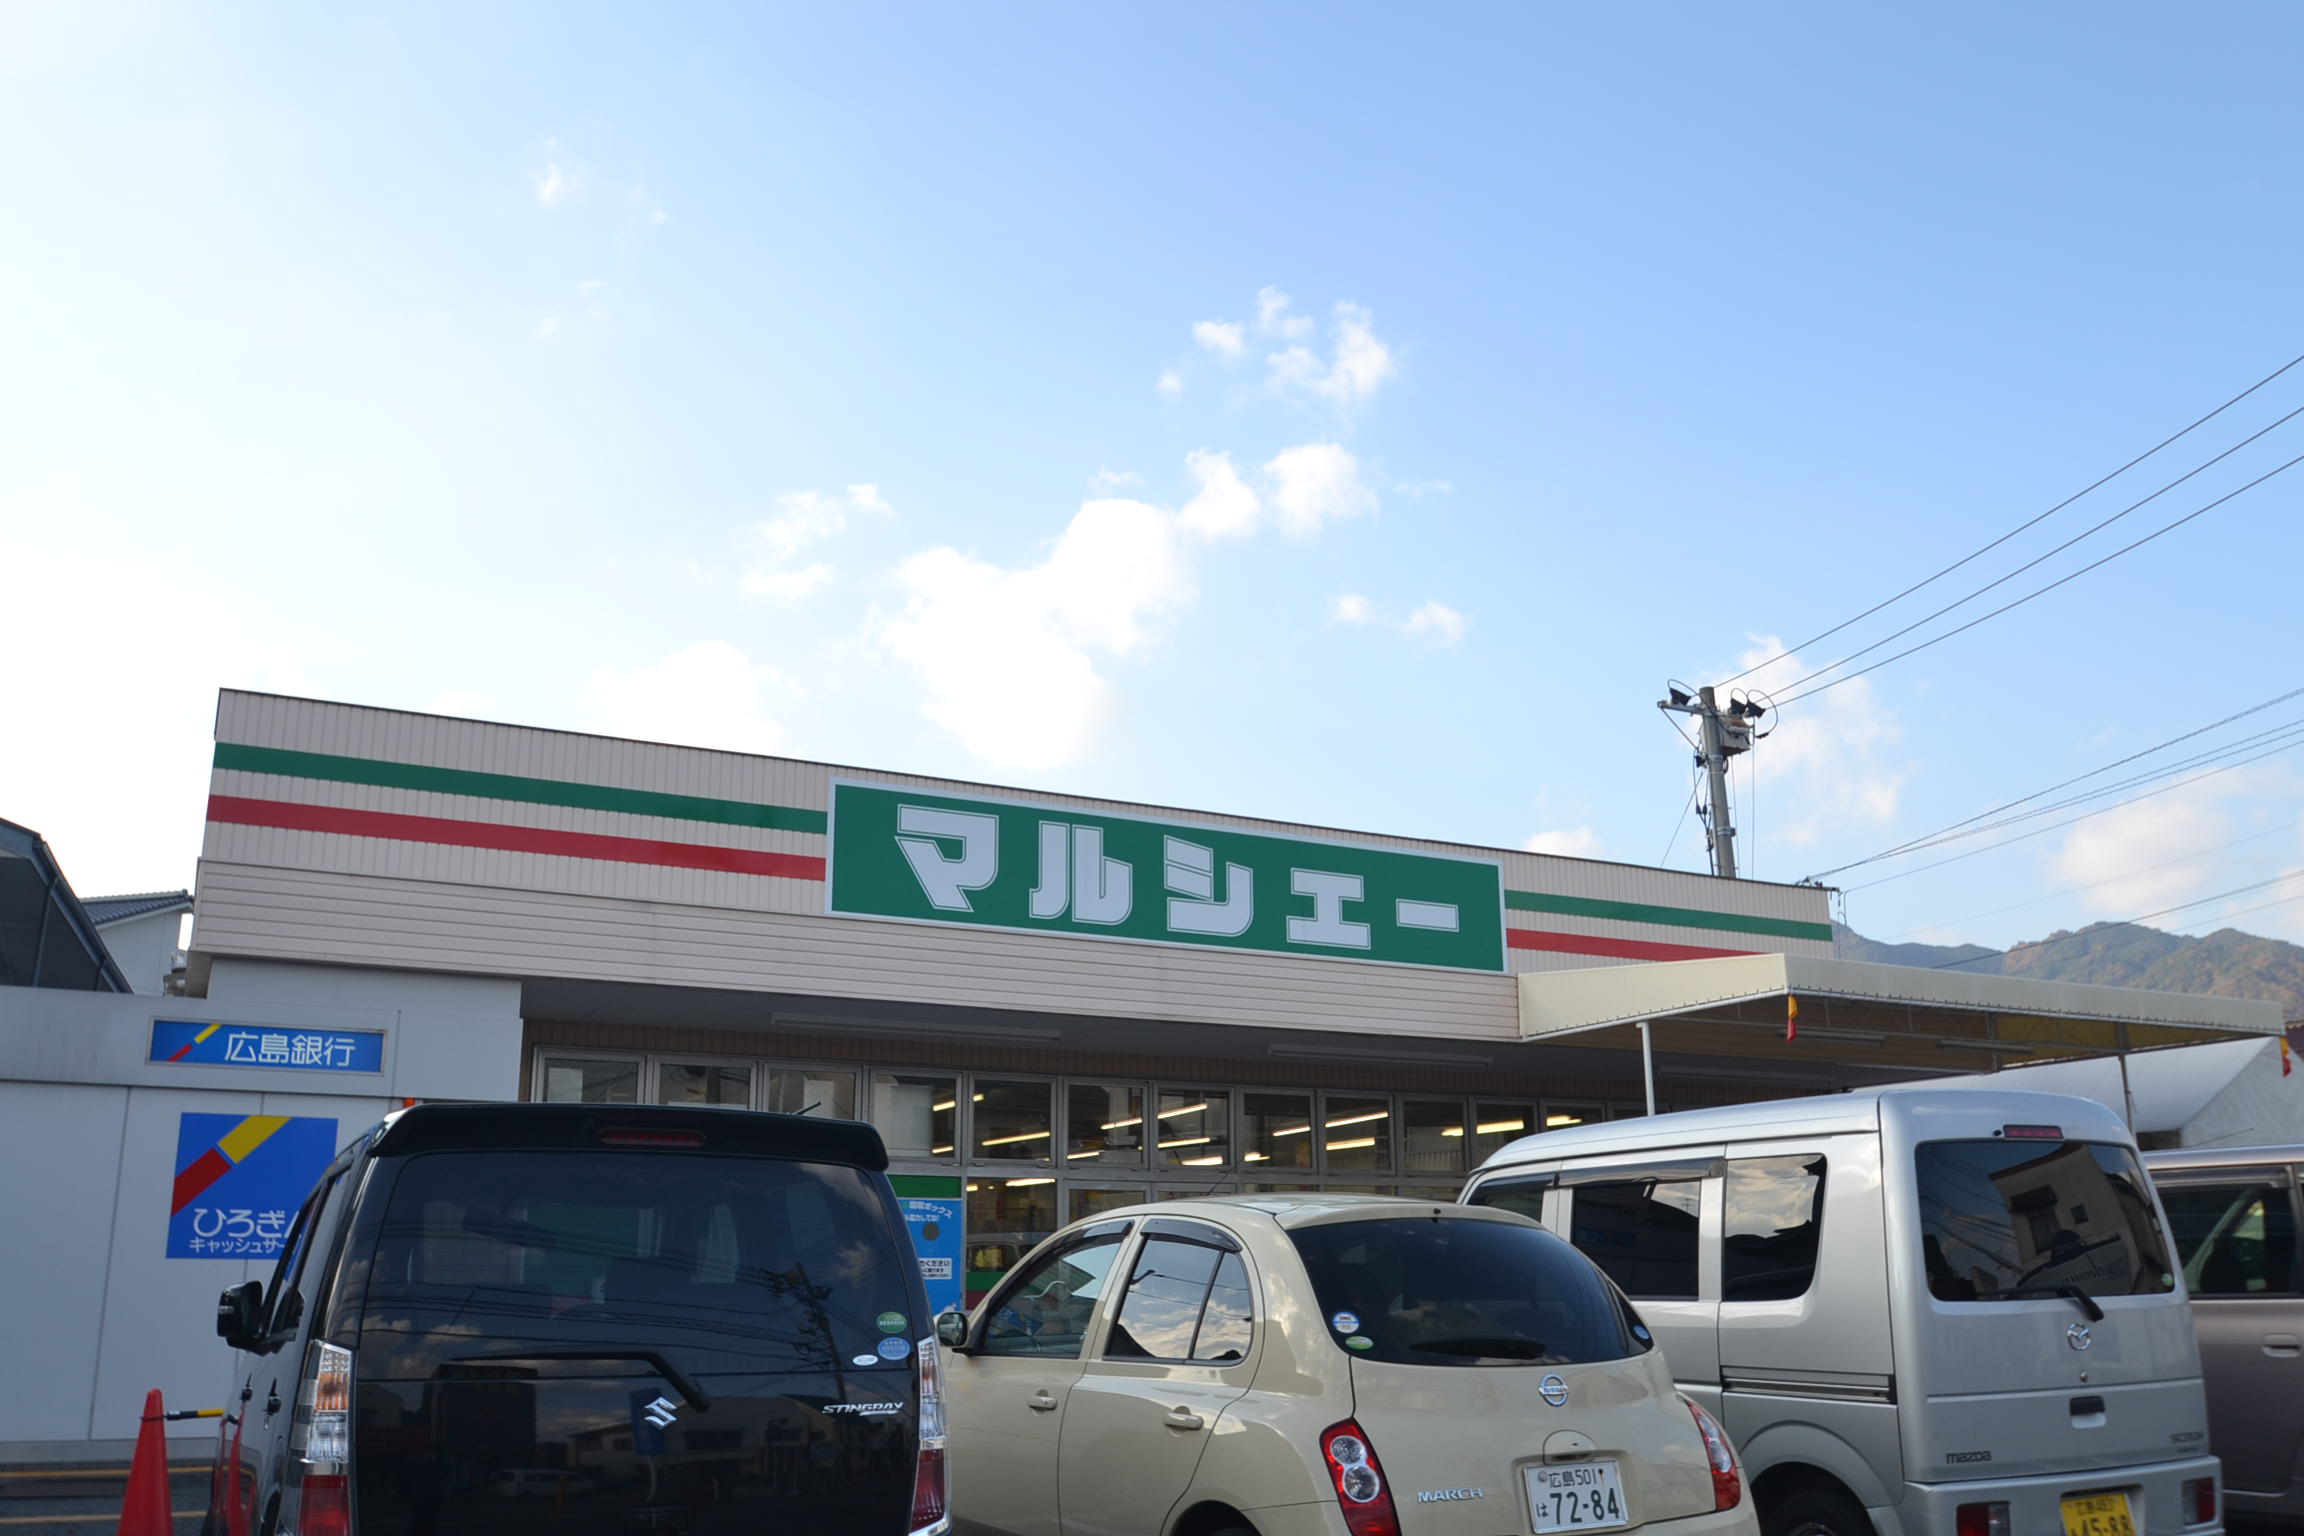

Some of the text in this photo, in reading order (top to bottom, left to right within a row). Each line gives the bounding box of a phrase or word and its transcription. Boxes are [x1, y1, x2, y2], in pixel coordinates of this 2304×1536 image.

[223, 1030, 356, 1067] 広島銀行
[821, 1401, 904, 1415] STINGRAY
[1417, 1487, 1485, 1503] MARCH
